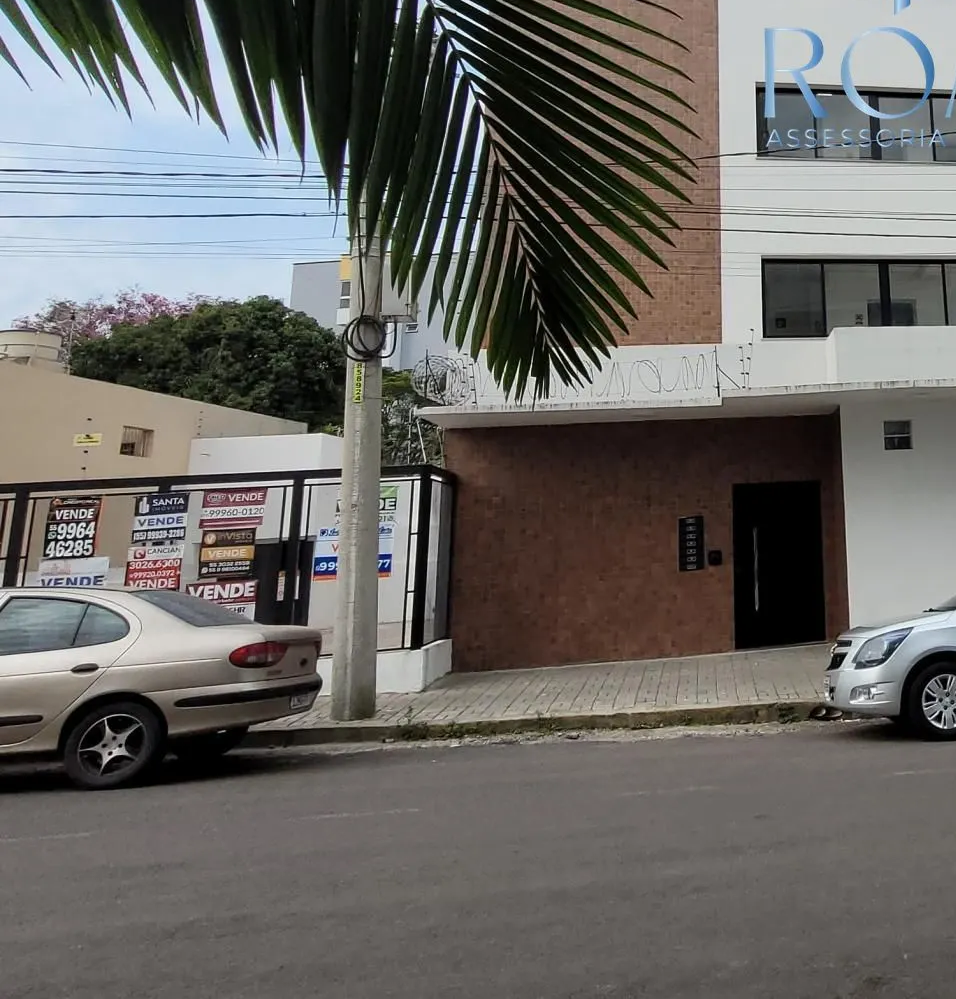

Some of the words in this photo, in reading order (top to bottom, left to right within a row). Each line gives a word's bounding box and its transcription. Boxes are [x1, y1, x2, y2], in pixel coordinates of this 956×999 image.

[152, 497, 185, 506] SANTA
[228, 492, 264, 502] VENDE
[55, 508, 95, 520] VENDE
[209, 508, 264, 517] 99960-0120
[138, 516, 184, 526] VENDE
[57, 522, 96, 540] 9964
[46, 540, 94, 558] 46285
[208, 548, 247, 558] VENDE
[41, 575, 105, 586] VENDE
[129, 578, 176, 589] VENDE
[188, 581, 256, 600] VENDE
